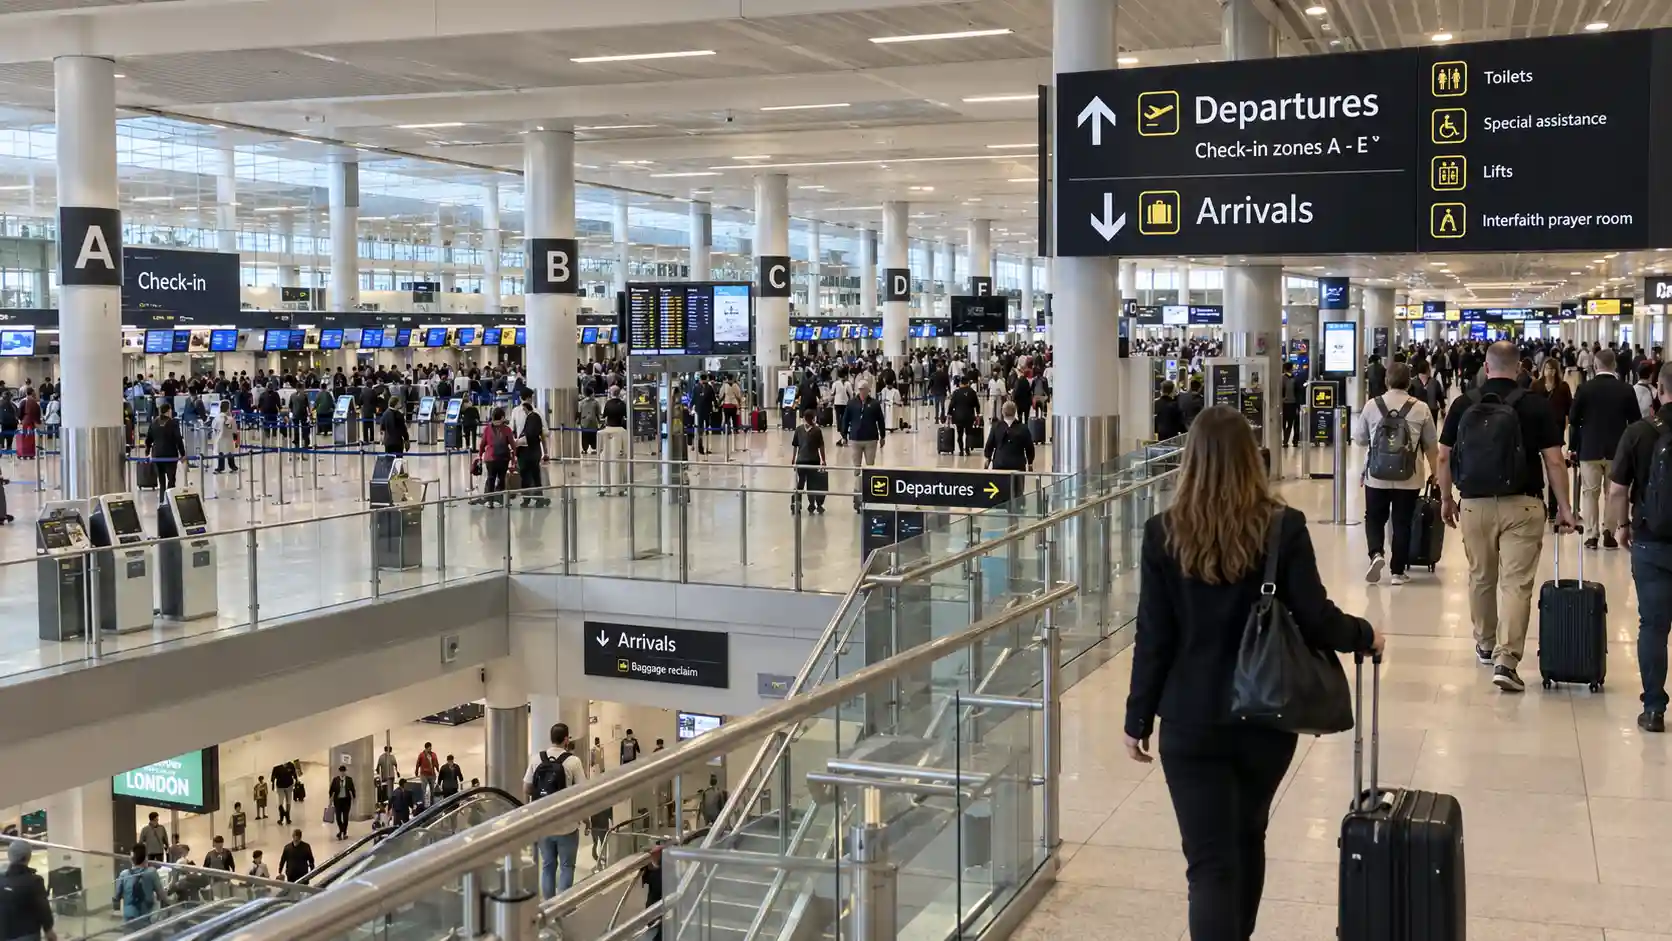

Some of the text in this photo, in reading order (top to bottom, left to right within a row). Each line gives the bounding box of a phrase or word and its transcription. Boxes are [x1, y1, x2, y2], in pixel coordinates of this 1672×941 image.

[1483, 69, 1533, 85] Toilets
[1195, 92, 1379, 130] Departures
[1484, 113, 1607, 133] Special assistance
[1195, 140, 1268, 159] Check-in
[1272, 142, 1323, 156] zones
[1326, 137, 1341, 154] A
[1483, 164, 1513, 178] Lifts
[1196, 193, 1314, 225] Arrivals
[1483, 212, 1633, 229] Interfaith prayer room
[74, 225, 115, 269] A
[547, 250, 570, 283] B
[769, 264, 786, 289] C
[138, 271, 206, 291] Check-in
[894, 275, 907, 295] D
[895, 479, 974, 498] Departures
[617, 631, 676, 652] Arrivals
[631, 661, 698, 677] Baggage reclaim
[126, 771, 189, 797] LONDON
